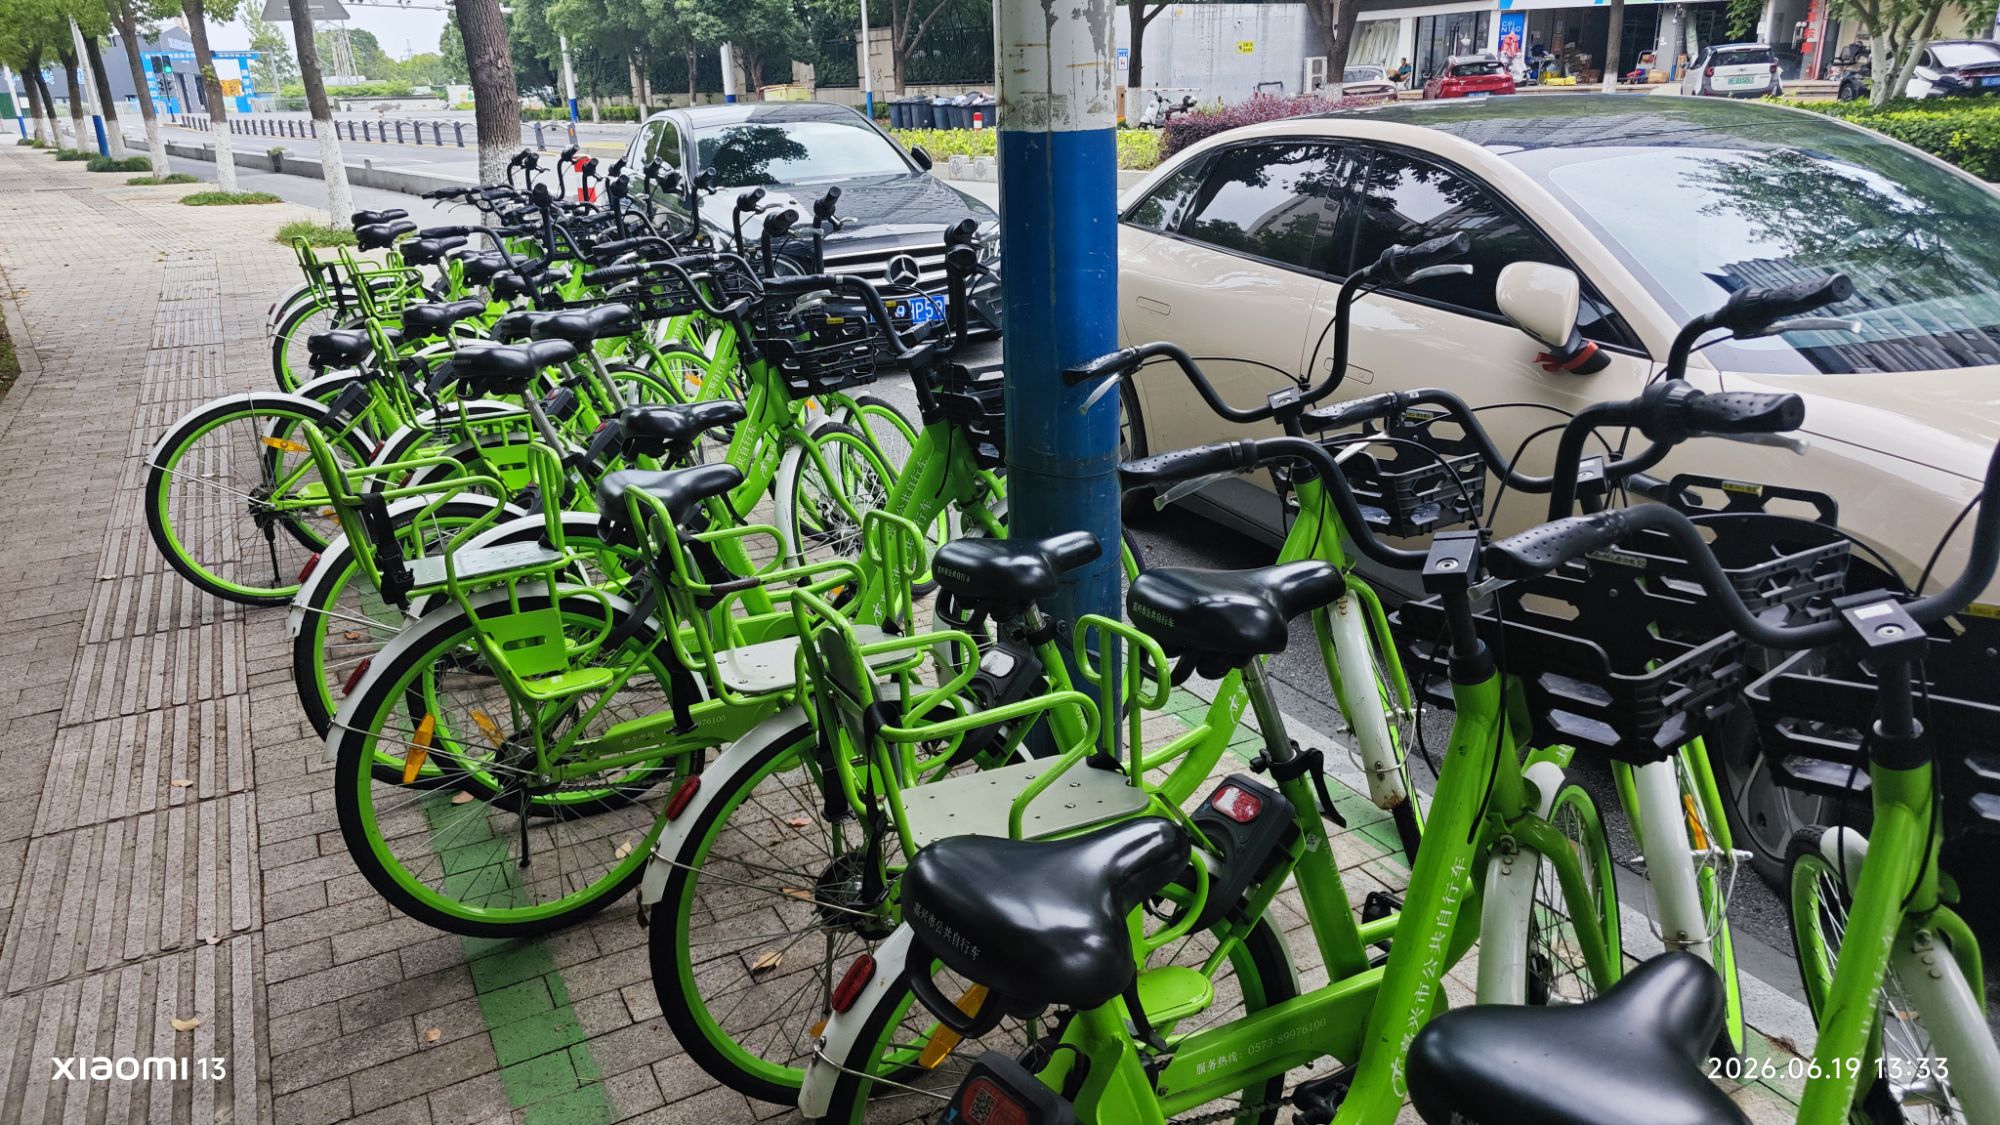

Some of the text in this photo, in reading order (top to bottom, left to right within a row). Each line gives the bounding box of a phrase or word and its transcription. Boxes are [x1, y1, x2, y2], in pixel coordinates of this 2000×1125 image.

[913, 901, 981, 961] 嘉兴市公共自行车
